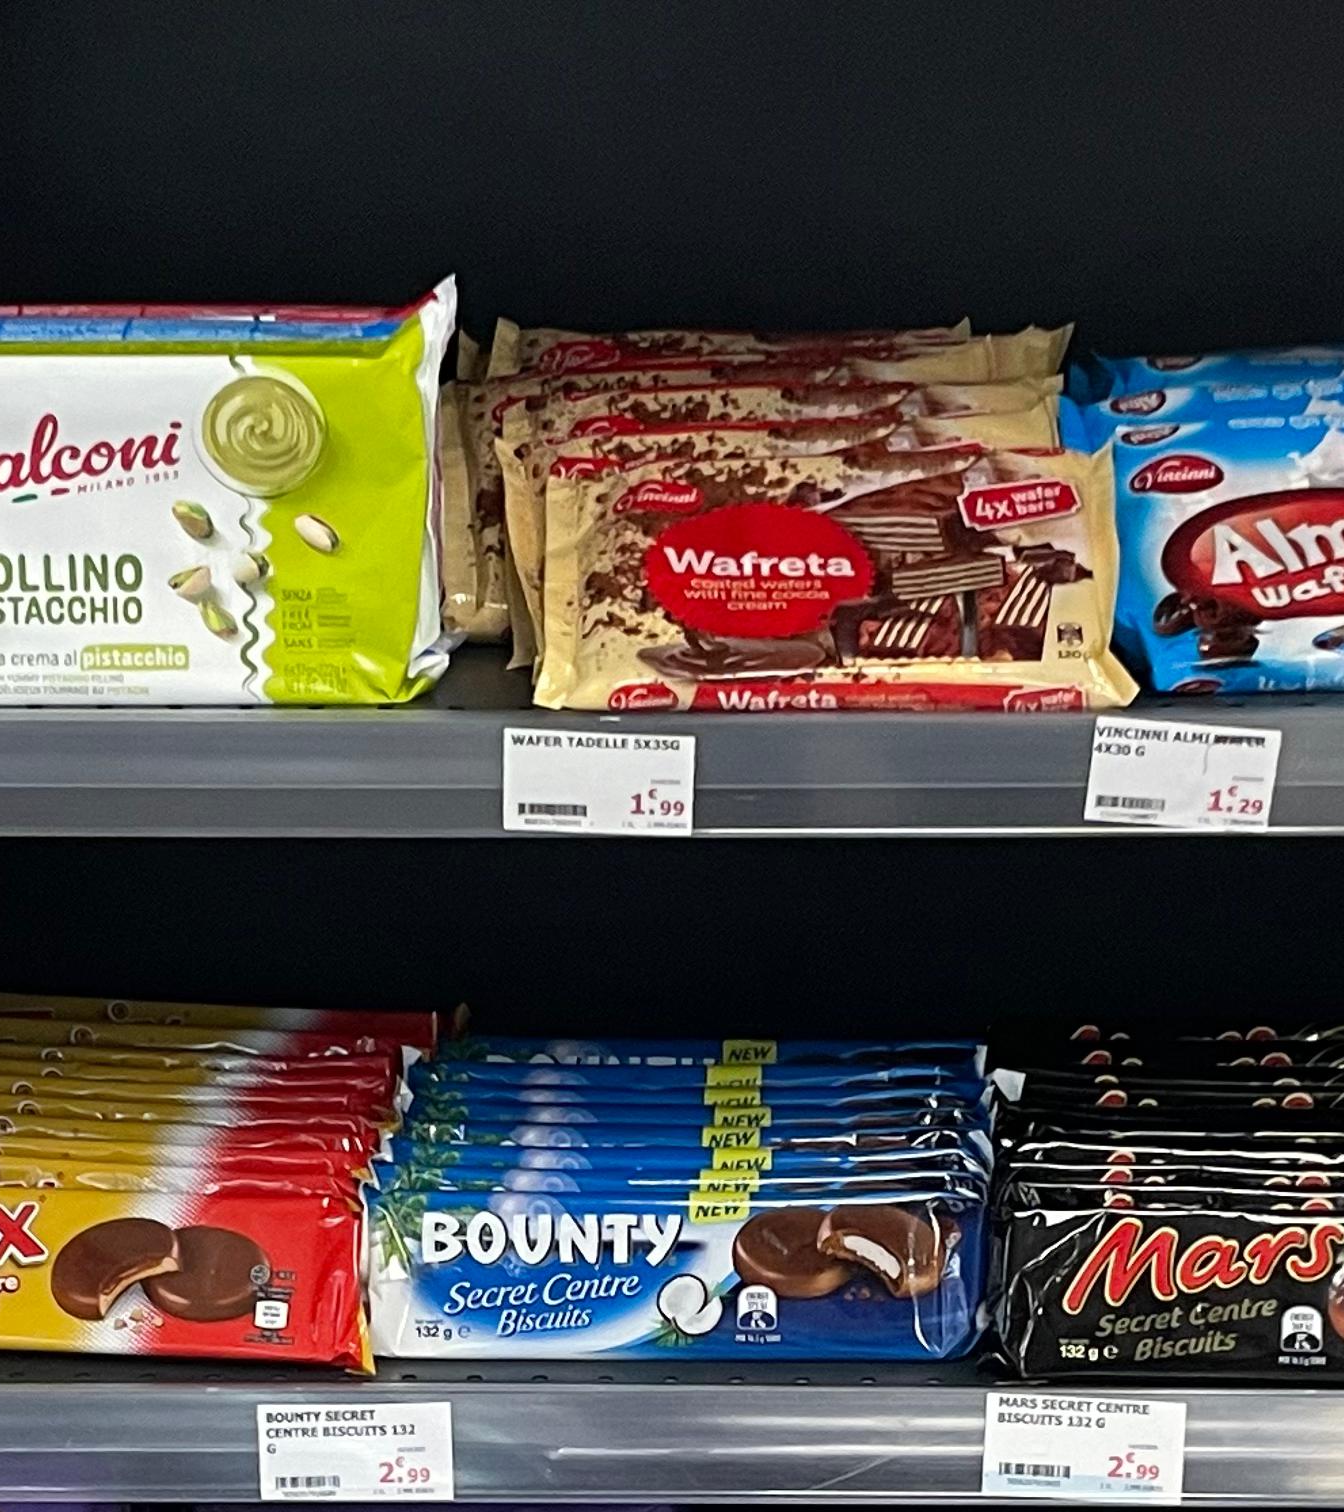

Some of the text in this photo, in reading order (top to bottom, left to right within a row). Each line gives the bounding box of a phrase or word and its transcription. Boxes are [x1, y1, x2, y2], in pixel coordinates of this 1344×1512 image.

[1136, 464, 1217, 488] Vincinni
[663, 546, 855, 578] Wafreta
[11, 652, 59, 666] crema
[64, 650, 77, 666] al
[83, 646, 186, 669] pistacchio
[716, 689, 838, 710] Wafreta
[511, 735, 628, 749] WAFER TADELLE
[1096, 727, 1168, 742] VINCINNI
[1094, 743, 1131, 755] 4X30
[695, 1201, 742, 1220] NEW
[421, 1211, 683, 1266] BOUNTY
[443, 1272, 643, 1316] Secret Centre
[495, 1307, 592, 1337] Biscuits
[1096, 1298, 1278, 1338] Secret Centre
[1135, 1330, 1238, 1361] Biscuits
[999, 1396, 1150, 1415] MARS SECRET CENTRE
[266, 1410, 375, 1423] BOUNTY SECRET
[998, 1413, 1062, 1426] BISCUITS
[266, 1424, 416, 1439] CENTRE BISCUITS 132
